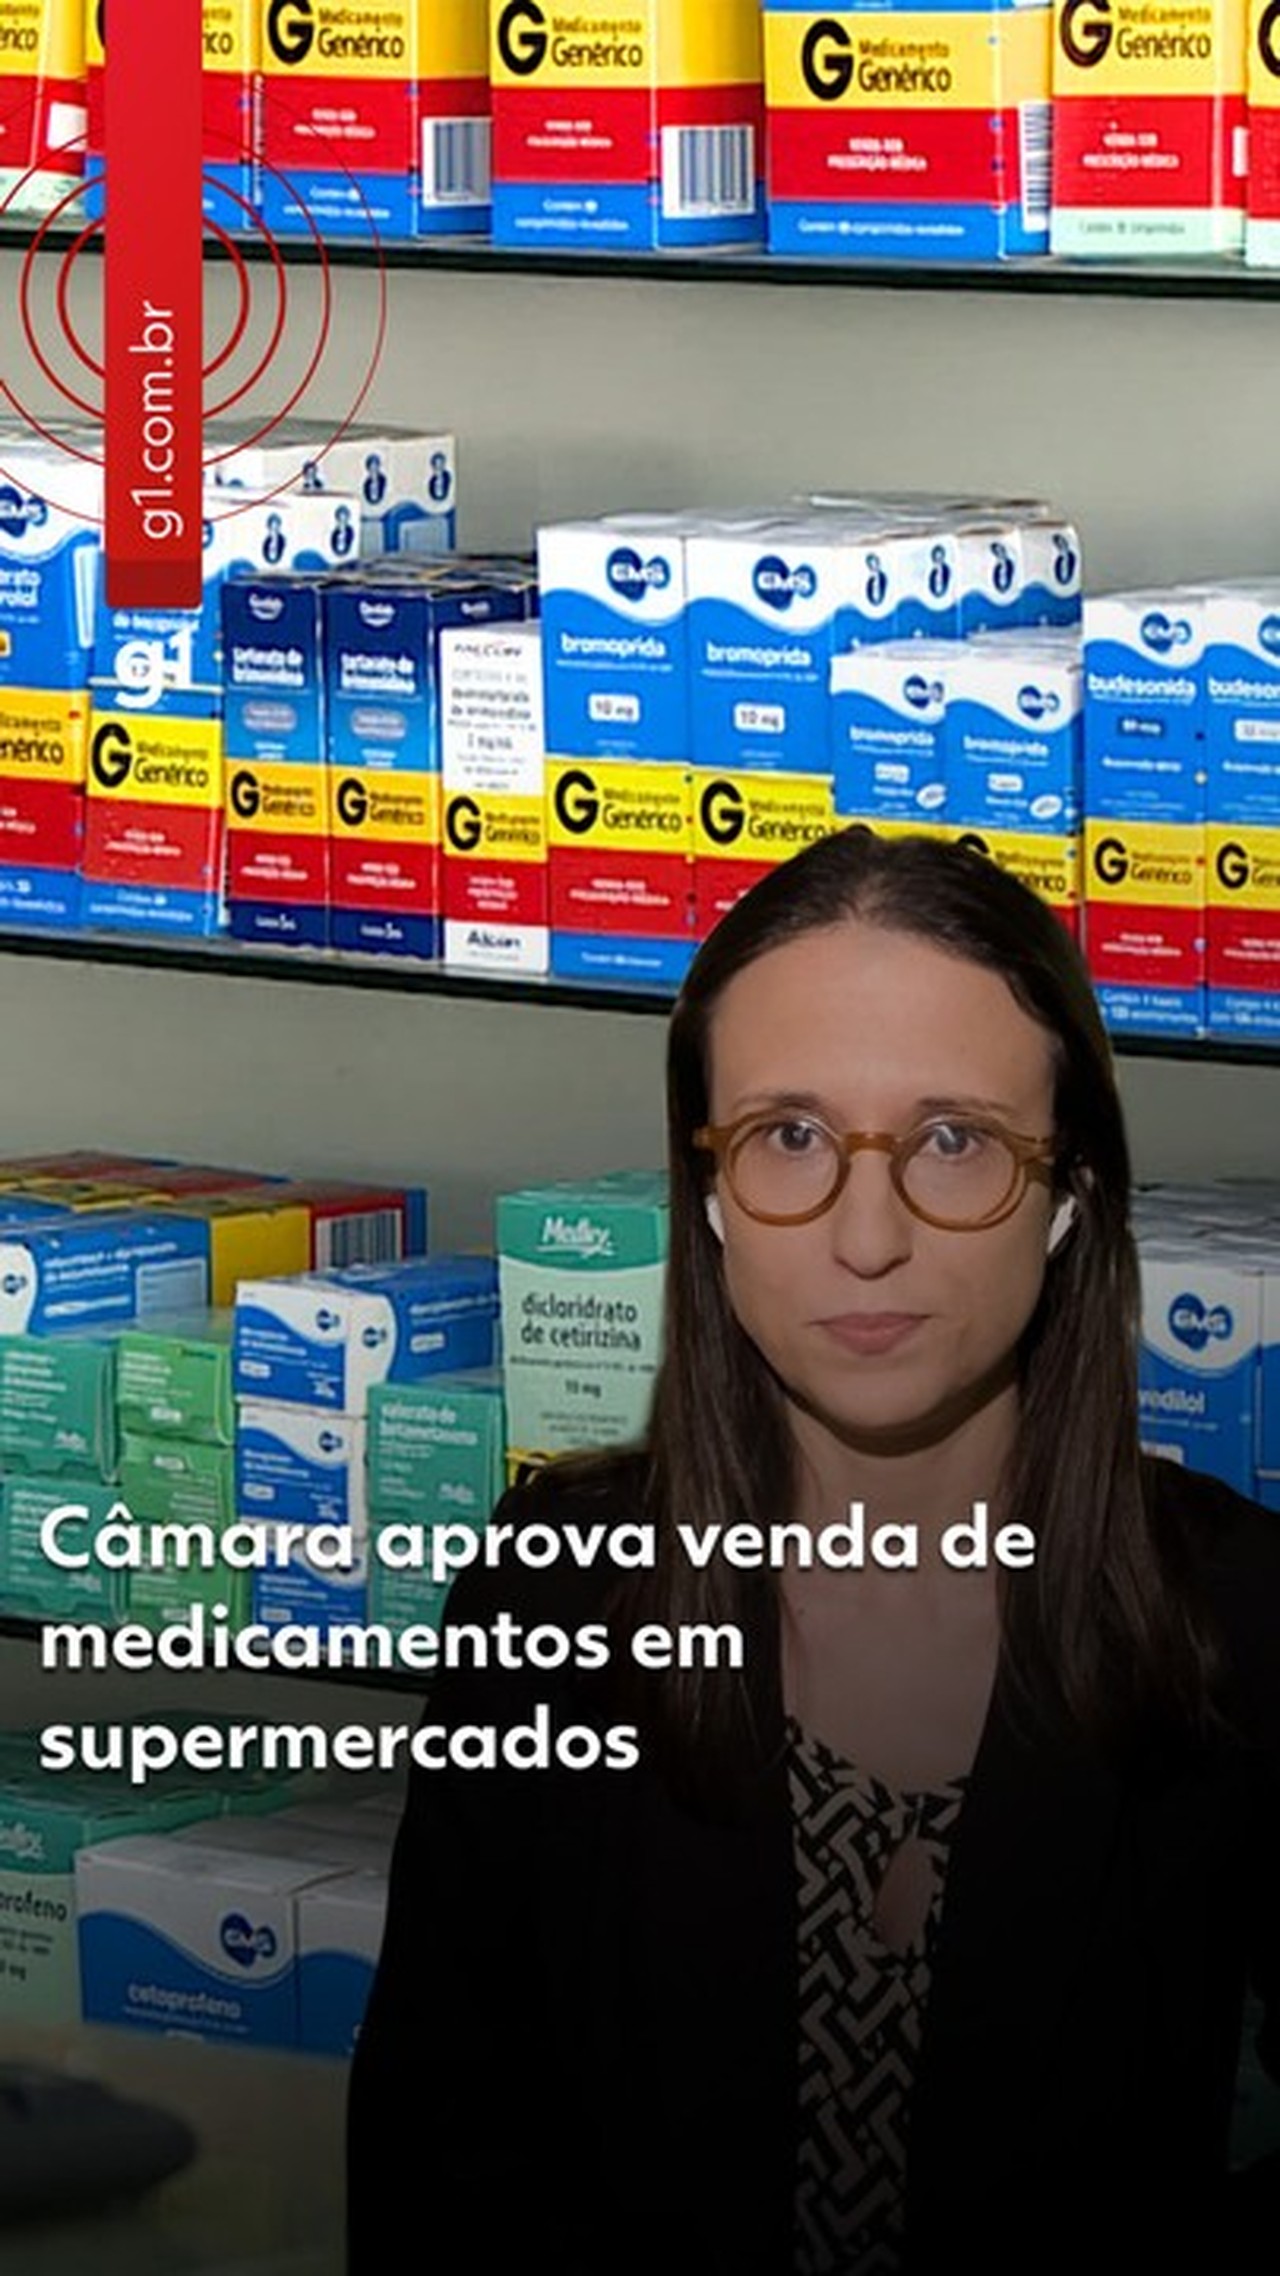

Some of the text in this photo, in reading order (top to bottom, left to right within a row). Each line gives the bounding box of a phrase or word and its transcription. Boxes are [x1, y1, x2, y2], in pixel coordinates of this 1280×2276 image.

[268, 0, 314, 65] G
[318, 28, 404, 58] Genérico
[498, 0, 548, 75] G
[1060, 0, 1114, 67] G
[1117, 26, 1212, 59] Genérico
[552, 36, 643, 67] Genérico
[802, 19, 854, 100] G
[858, 59, 952, 93] Genérico
[561, 632, 667, 659] bromoprida
[707, 641, 813, 669] bromoprida
[1088, 673, 1197, 695] budesonida
[92, 723, 132, 788] G
[134, 757, 209, 788] Genérico
[231, 770, 260, 819] G
[337, 777, 368, 827] G
[555, 769, 599, 834] G
[700, 780, 745, 845] G
[446, 796, 482, 851] G
[602, 804, 682, 832] Genérico
[748, 815, 826, 843] Genérico
[1094, 838, 1129, 885] G
[1216, 842, 1250, 890] G
[522, 1292, 638, 1323] dicloridrato
[521, 1320, 642, 1351] de cetirizina
[128, 1983, 242, 2020] cetoprofeno
